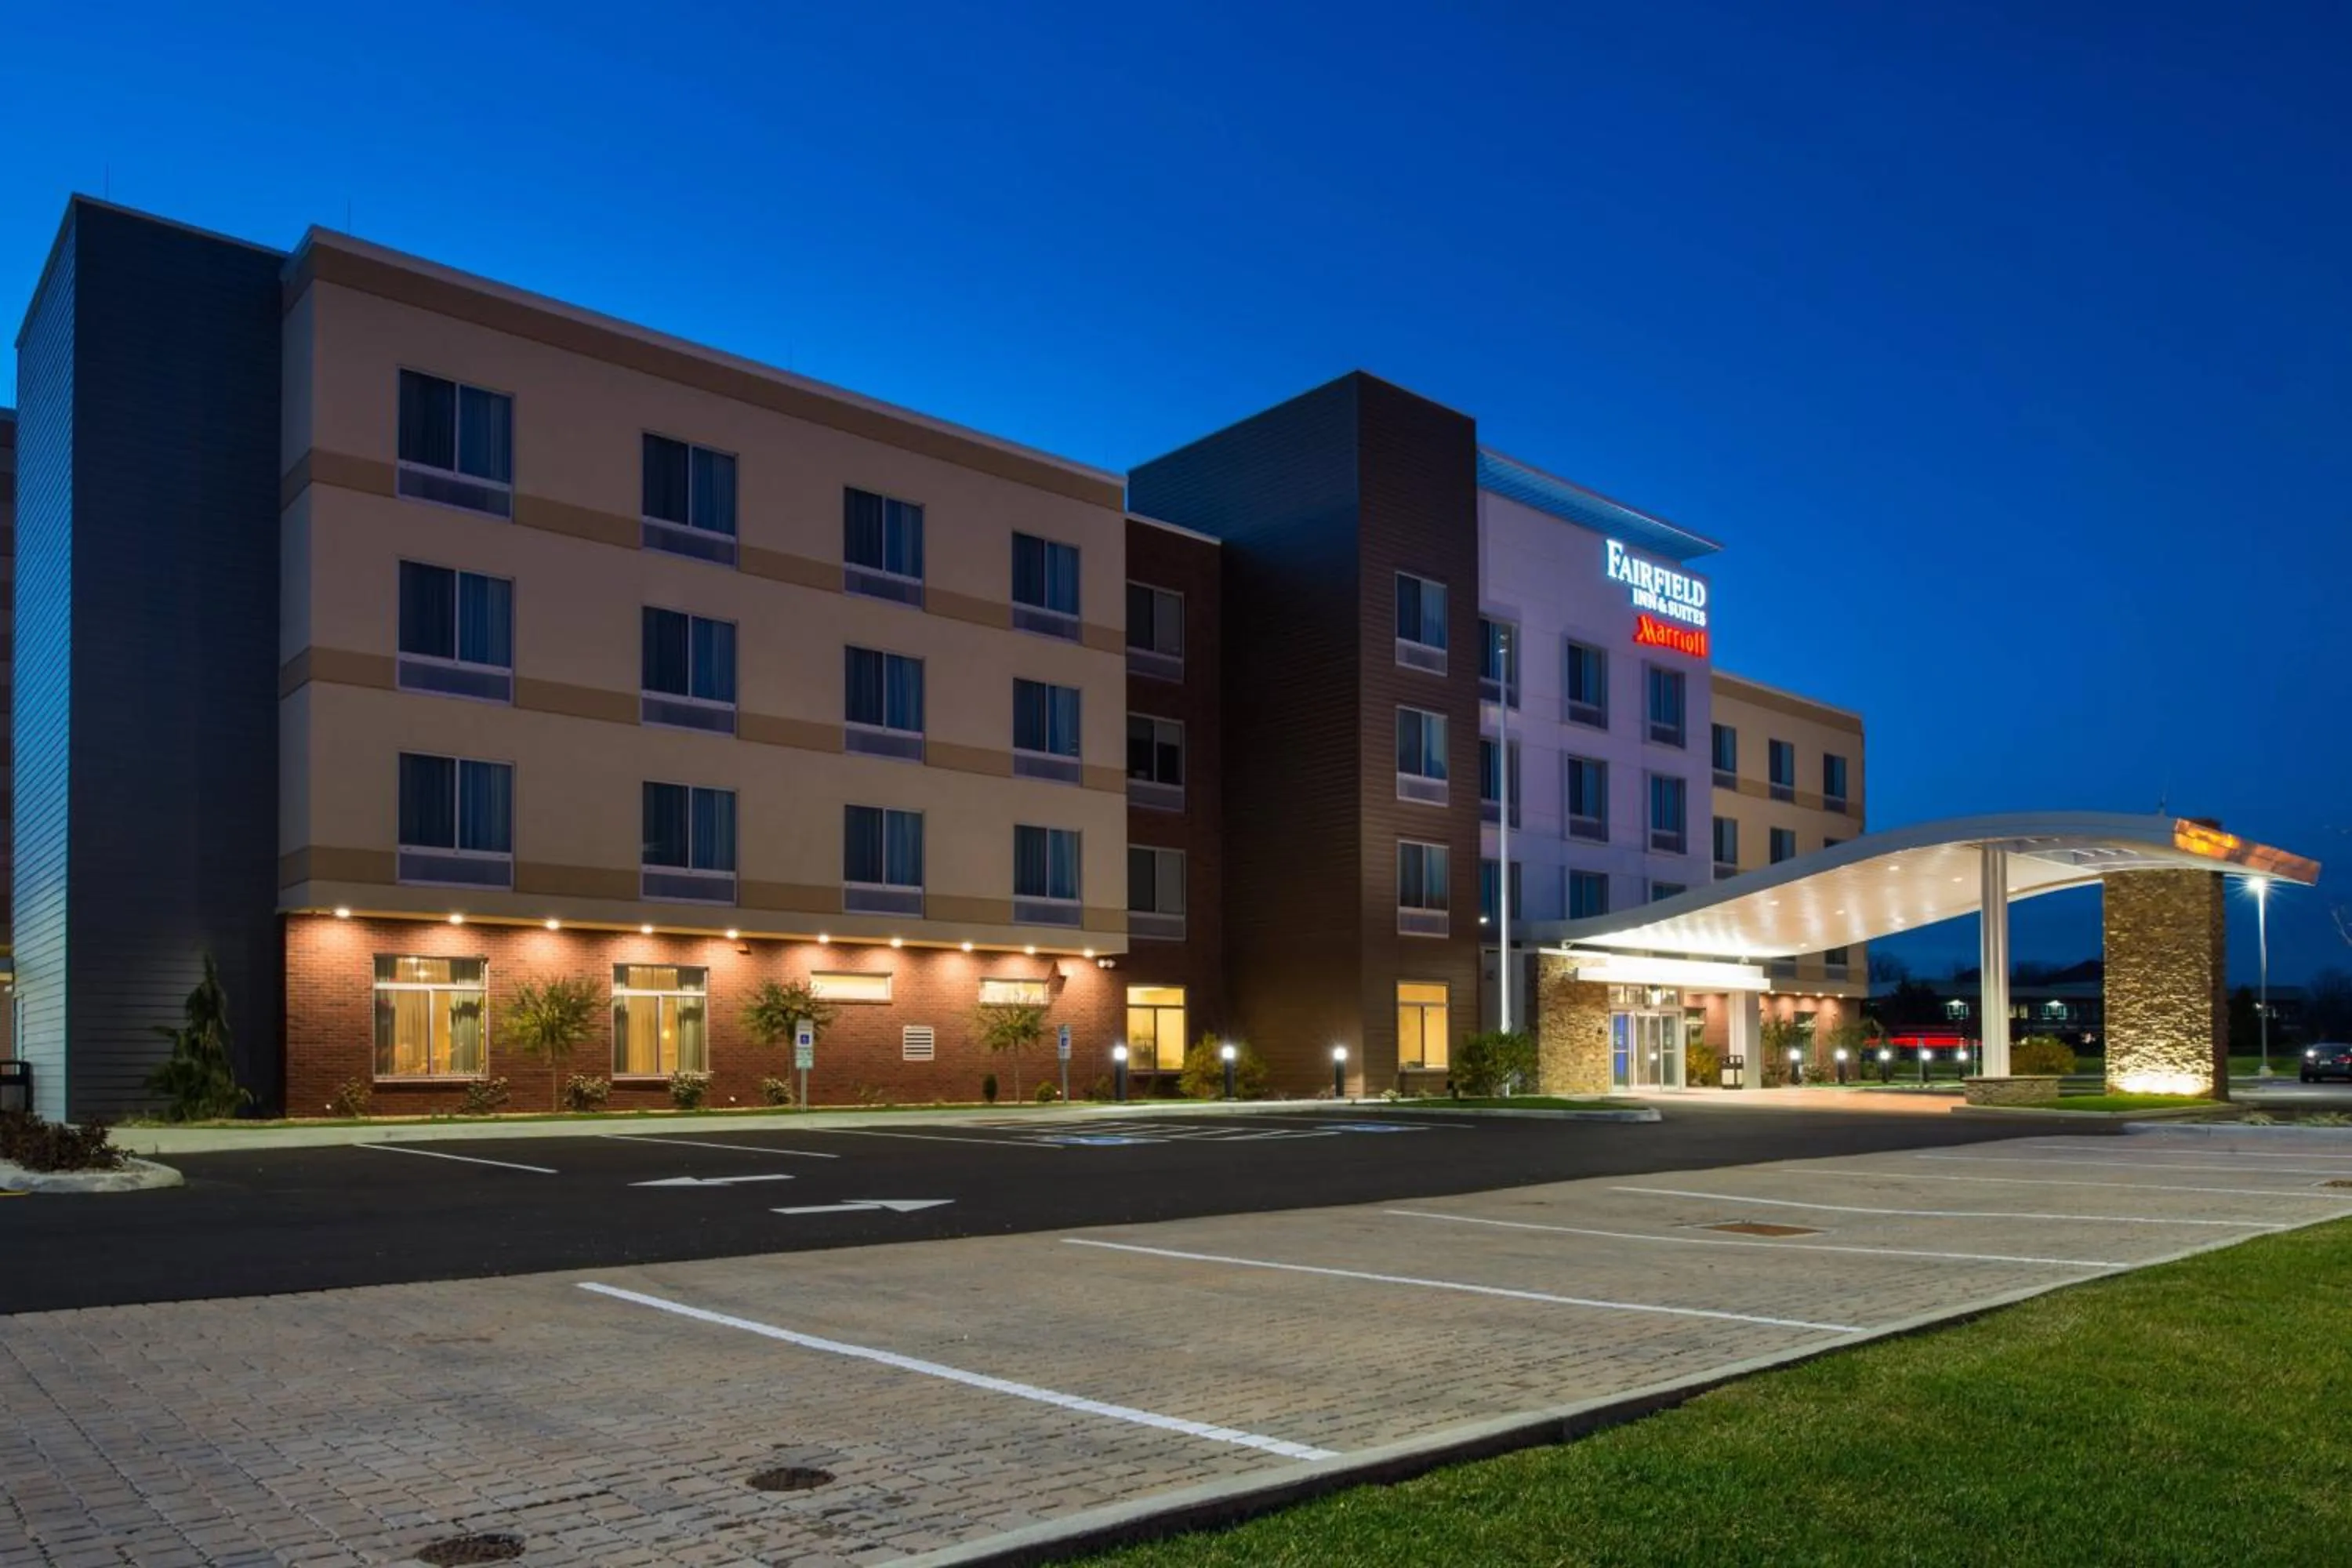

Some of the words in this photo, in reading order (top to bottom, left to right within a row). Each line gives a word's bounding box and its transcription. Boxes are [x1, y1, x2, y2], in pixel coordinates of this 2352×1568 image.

[1606, 539, 1706, 608] FAIRFIELD
[1633, 588, 1657, 610] INN
[1657, 597, 1668, 614] &
[1668, 601, 1707, 626] SUITES
[1635, 614, 1707, 655] Marriott
